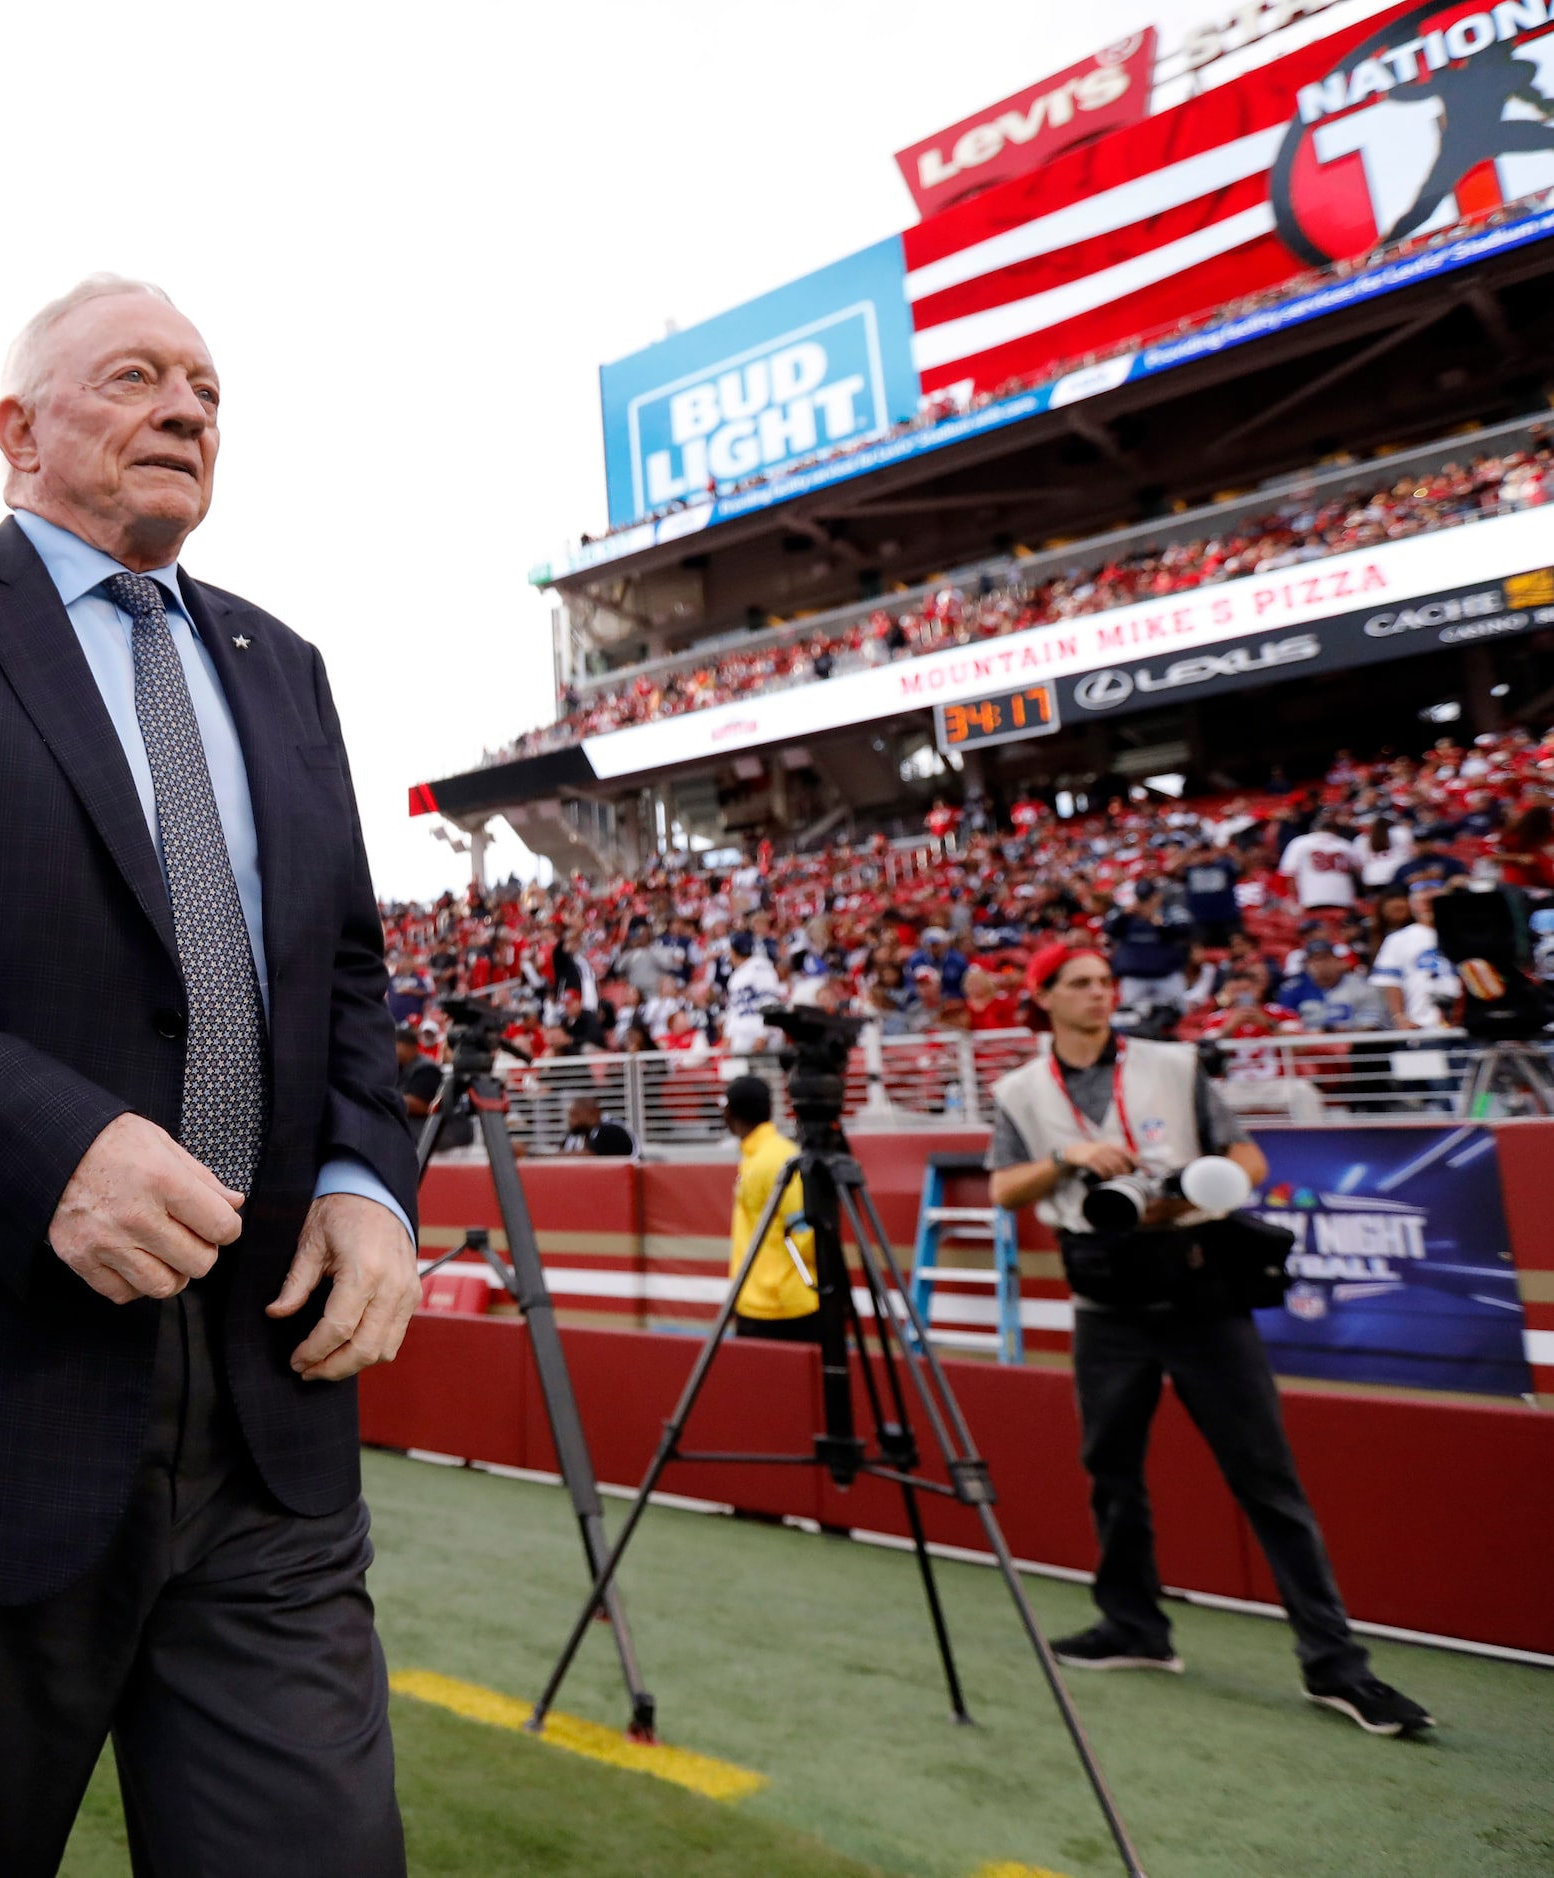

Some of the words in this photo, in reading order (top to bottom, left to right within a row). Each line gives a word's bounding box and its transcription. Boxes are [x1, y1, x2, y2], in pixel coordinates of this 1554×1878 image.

[1296, 0, 1554, 125] NATION
[646, 373, 865, 505] LIGHT
[670, 341, 829, 445] BUD
[900, 637, 1077, 697] MOUNTAIN
[1098, 598, 1234, 652] MIKE'S
[1253, 564, 1388, 617] PIZZA
[1134, 633, 1321, 692] LEXUS
[945, 686, 1053, 744] 34:17
[1311, 1211, 1428, 1260] NIGHT
